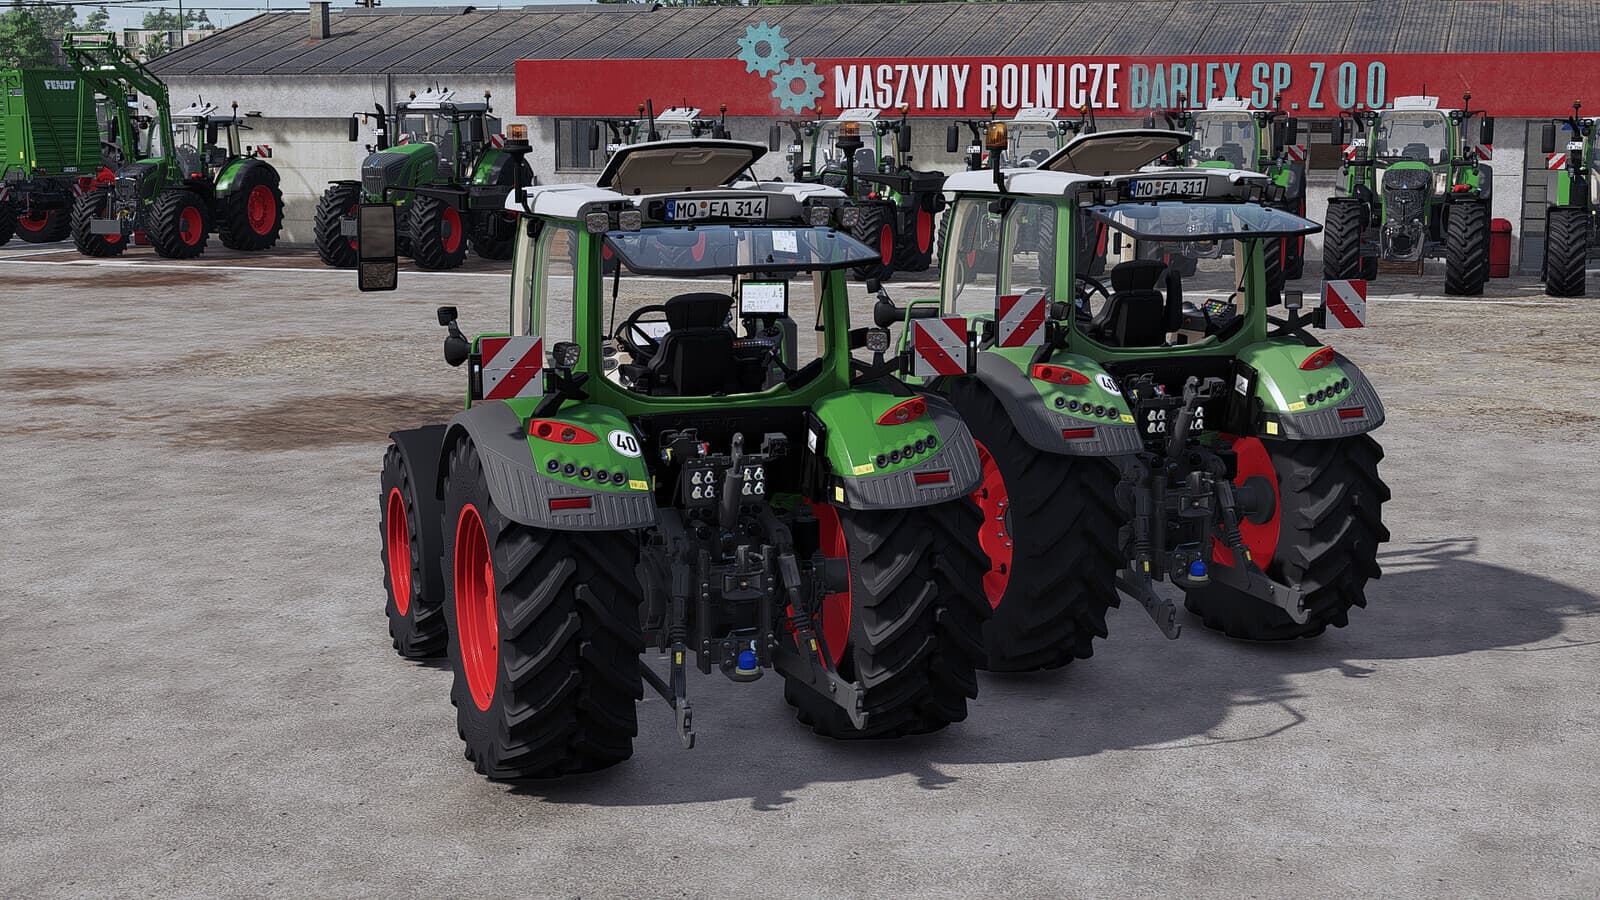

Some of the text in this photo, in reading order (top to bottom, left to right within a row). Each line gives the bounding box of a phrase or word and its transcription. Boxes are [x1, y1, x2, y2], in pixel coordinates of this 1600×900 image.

[44, 80, 76, 90] FENDT
[835, 64, 970, 109] MASZYNY
[981, 63, 1120, 109] ROLNICZE
[1131, 63, 1240, 109] BARLEX
[1252, 62, 1298, 109] SP.
[1308, 63, 1325, 109] Z
[1137, 181, 1202, 195] MO FA 311
[676, 201, 763, 218] MO FA 314
[1101, 376, 1119, 392] 40
[617, 434, 638, 452] 40
